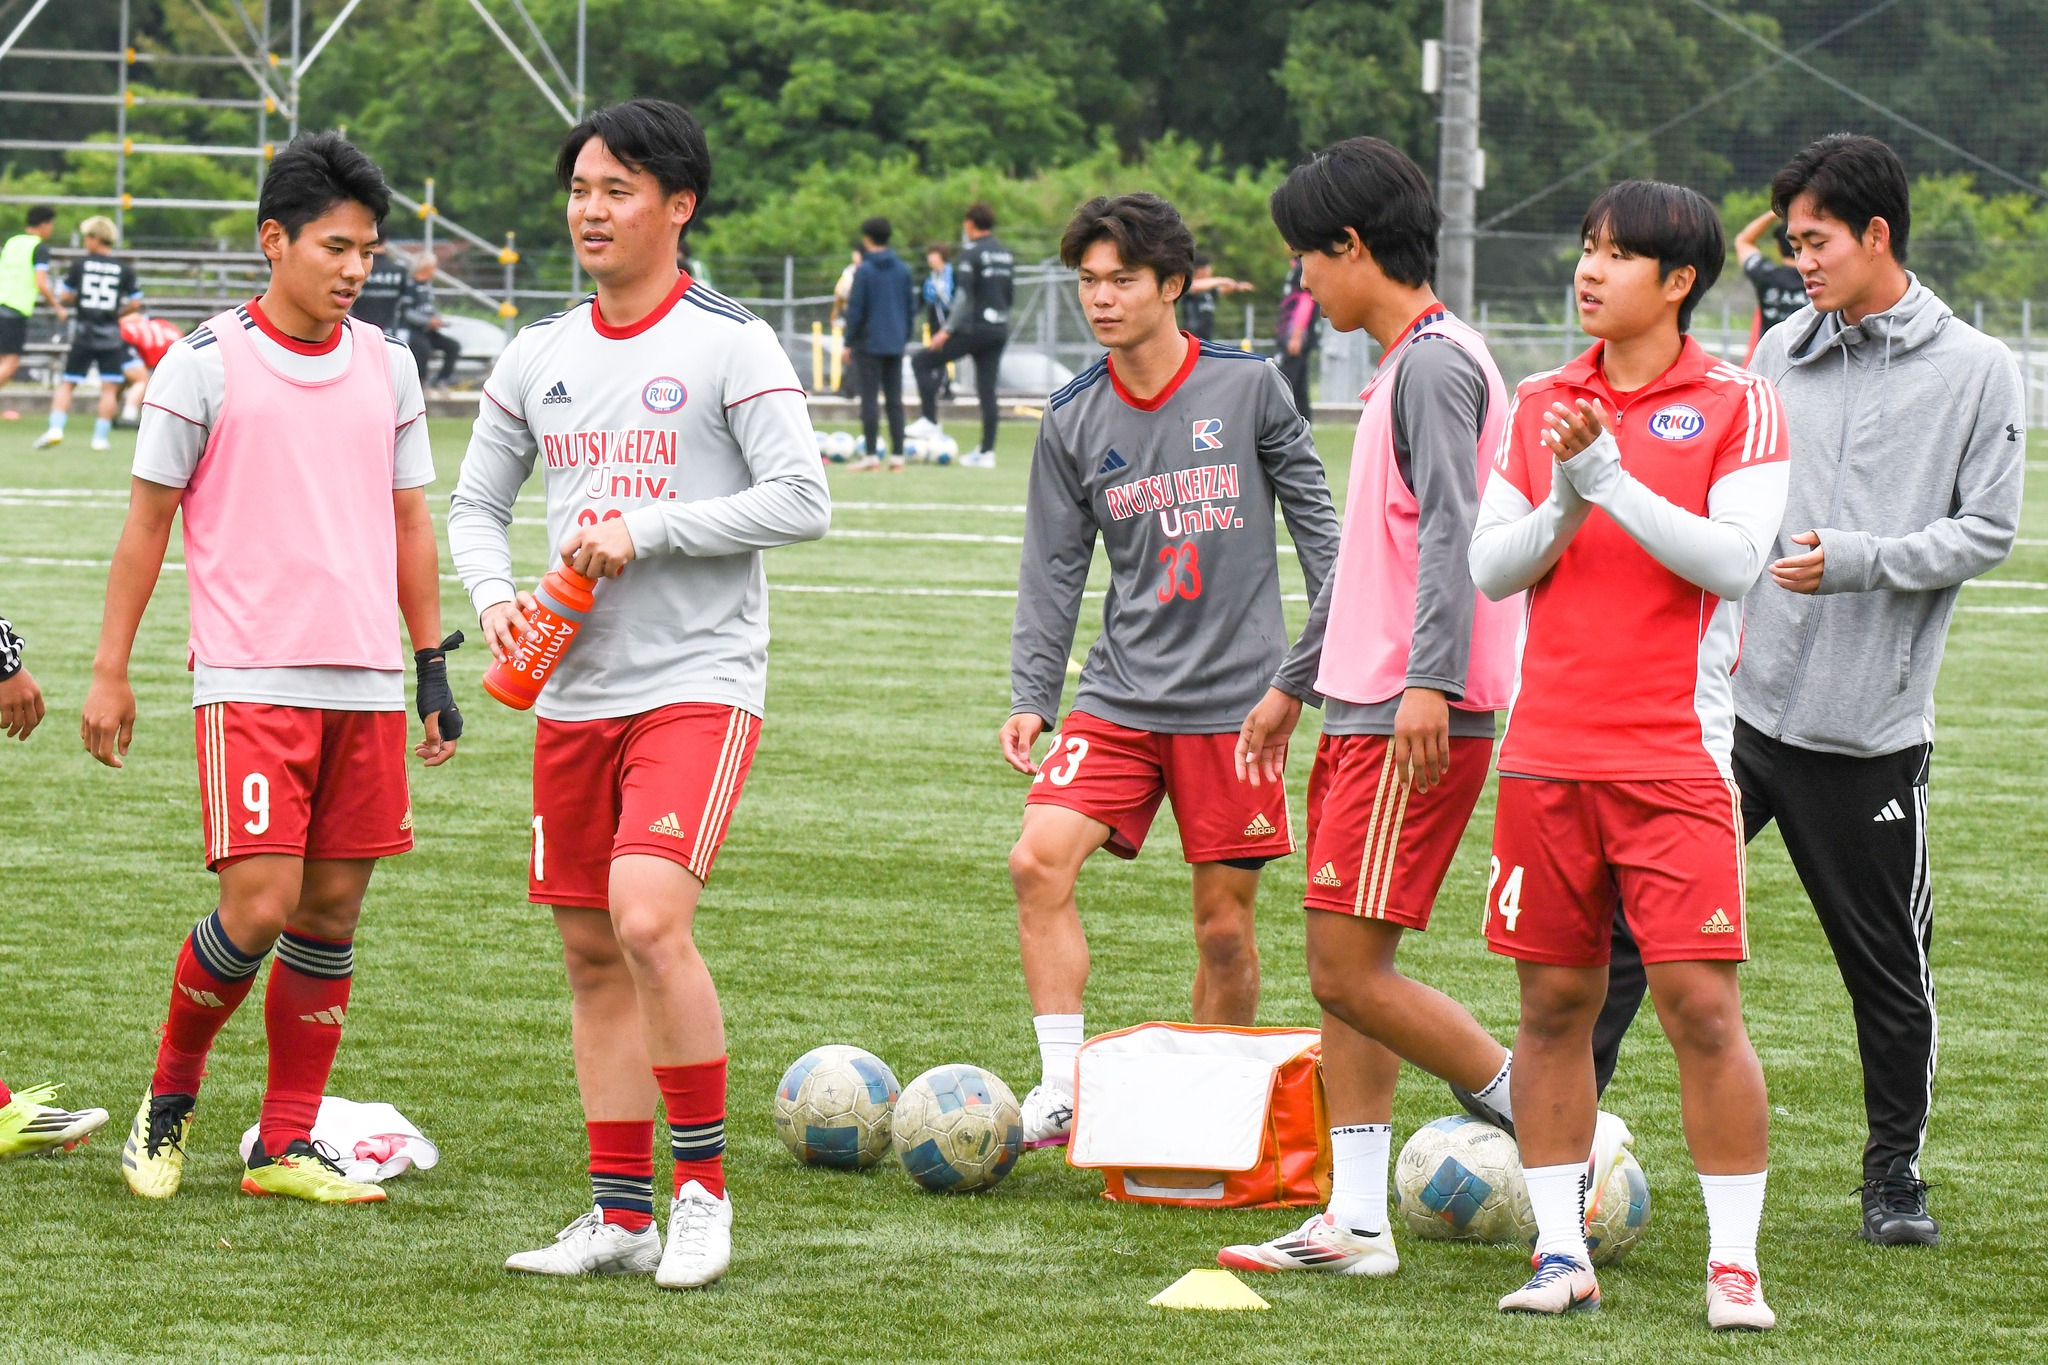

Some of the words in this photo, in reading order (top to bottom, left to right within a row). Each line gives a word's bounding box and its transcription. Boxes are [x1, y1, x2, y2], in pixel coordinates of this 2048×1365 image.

[80, 272, 120, 310] 55
[542, 395, 572, 405] adidas
[649, 387, 678, 402] RKU
[1657, 414, 1696, 431] RKU
[543, 430, 613, 468] RYUTSU
[611, 429, 678, 466] KEIZAI
[586, 466, 677, 499] Univ.
[1105, 472, 1173, 522] RYUTSU
[1173, 464, 1240, 505] KEIZAI
[1158, 501, 1244, 538] Univ.
[1157, 541, 1203, 603] 33
[531, 621, 574, 681] Amino
[242, 772, 270, 836] 9
[648, 824, 685, 839] adidas
[1243, 826, 1276, 836] adidas
[1312, 875, 1342, 887] adidas
[1700, 924, 1735, 934] adidas
[1467, 1131, 1501, 1146] molten
[1401, 1146, 1428, 1168] RKU
